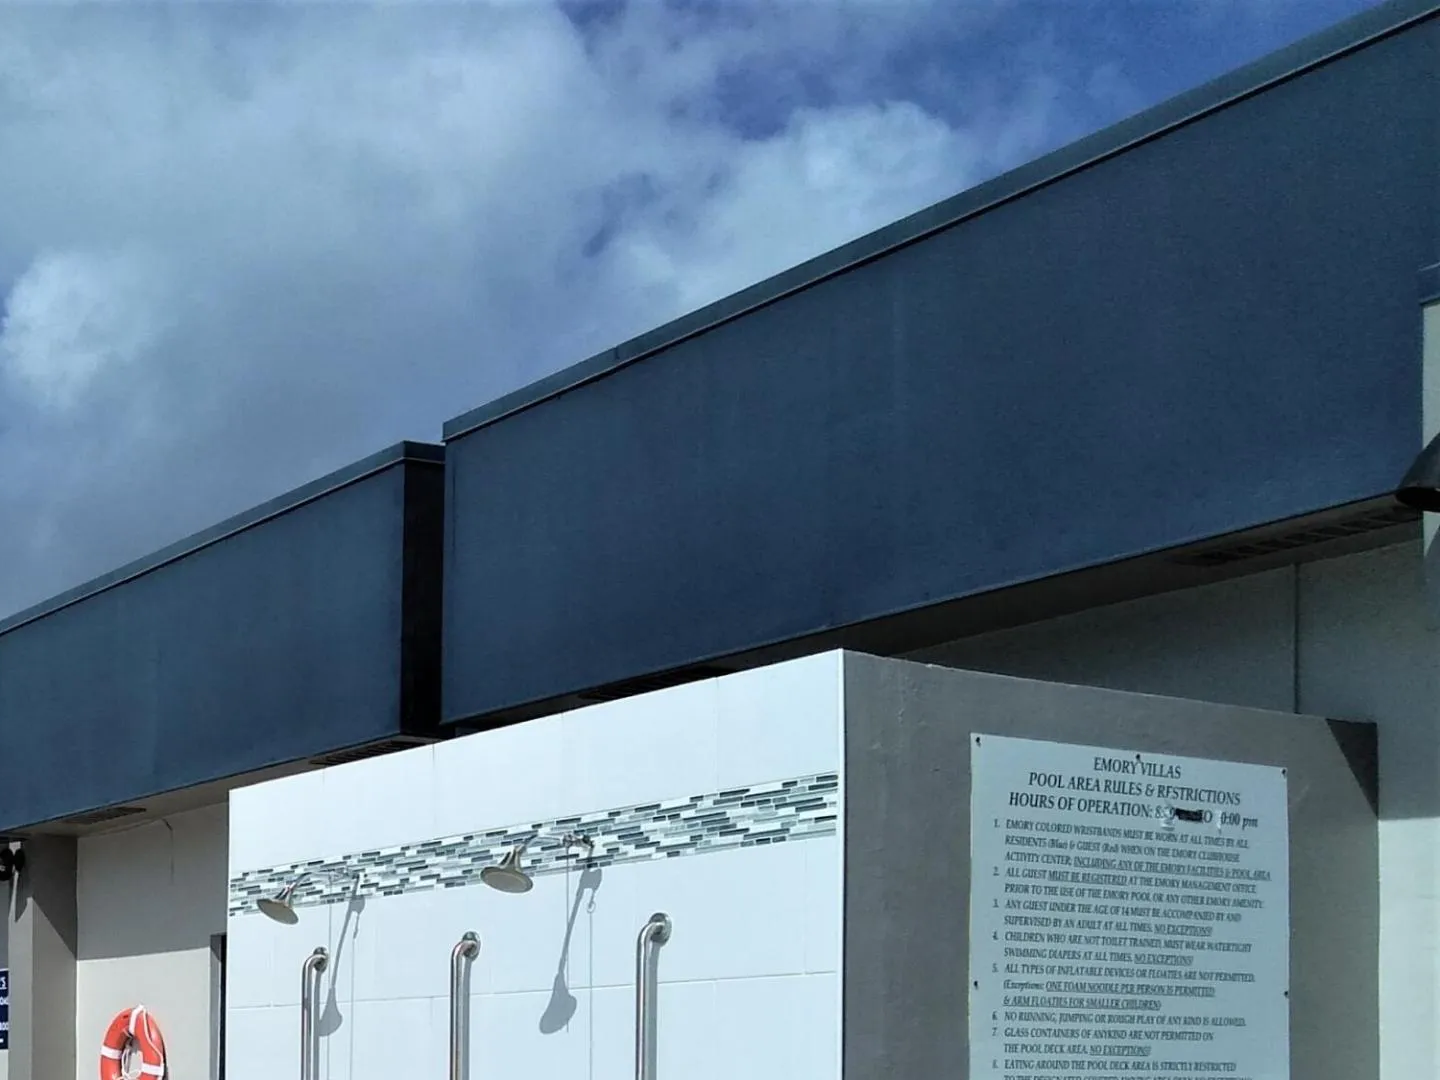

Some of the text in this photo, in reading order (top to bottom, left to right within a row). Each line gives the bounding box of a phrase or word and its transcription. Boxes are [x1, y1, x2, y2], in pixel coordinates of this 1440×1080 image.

[1093, 756, 1181, 779] EMORY VILLAS
[1028, 771, 1064, 789] POOL
[1066, 775, 1101, 792] AREA
[1103, 779, 1142, 796] RULES
[1144, 783, 1154, 797] &
[1008, 791, 1054, 809] HOURS
[1057, 795, 1075, 811] OF
[1077, 797, 1152, 818] OPERATION:
[1006, 819, 1033, 830] EMORY
[1035, 821, 1072, 833] COLORED
[1076, 840, 1100, 851] GUEST
[1006, 867, 1019, 877] ALL
[1021, 868, 1046, 879] GUEST
[1004, 883, 1028, 894] PRIOR
[1044, 885, 1057, 895] THE
[1004, 898, 1020, 909] ANY
[1022, 899, 1048, 910] GUEST
[1077, 903, 1091, 913] THE
[1093, 904, 1108, 914] AGE
[1005, 930, 1044, 942] CHILDREN
[1047, 933, 1065, 943] WHO
[1068, 934, 1082, 944] ARE
[1084, 935, 1100, 945] NOT
[1005, 962, 1018, 973] ALL
[1021, 963, 1044, 974] TYPES
[1004, 1011, 1017, 1021] NO
[1004, 1027, 1029, 1037] GLASS
[1030, 1028, 1079, 1038] CONTAINERS
[1129, 1030, 1142, 1040] ARE
[1144, 1031, 1160, 1040] NOT
[1004, 1043, 1064, 1053] THE POOL DECK
[1004, 1059, 1034, 1068] EATING
[1036, 1059, 1069, 1069] AROUND
[1071, 1060, 1085, 1069] THE
[1087, 1060, 1107, 1069] POOL
[1109, 1060, 1128, 1070] DECK
